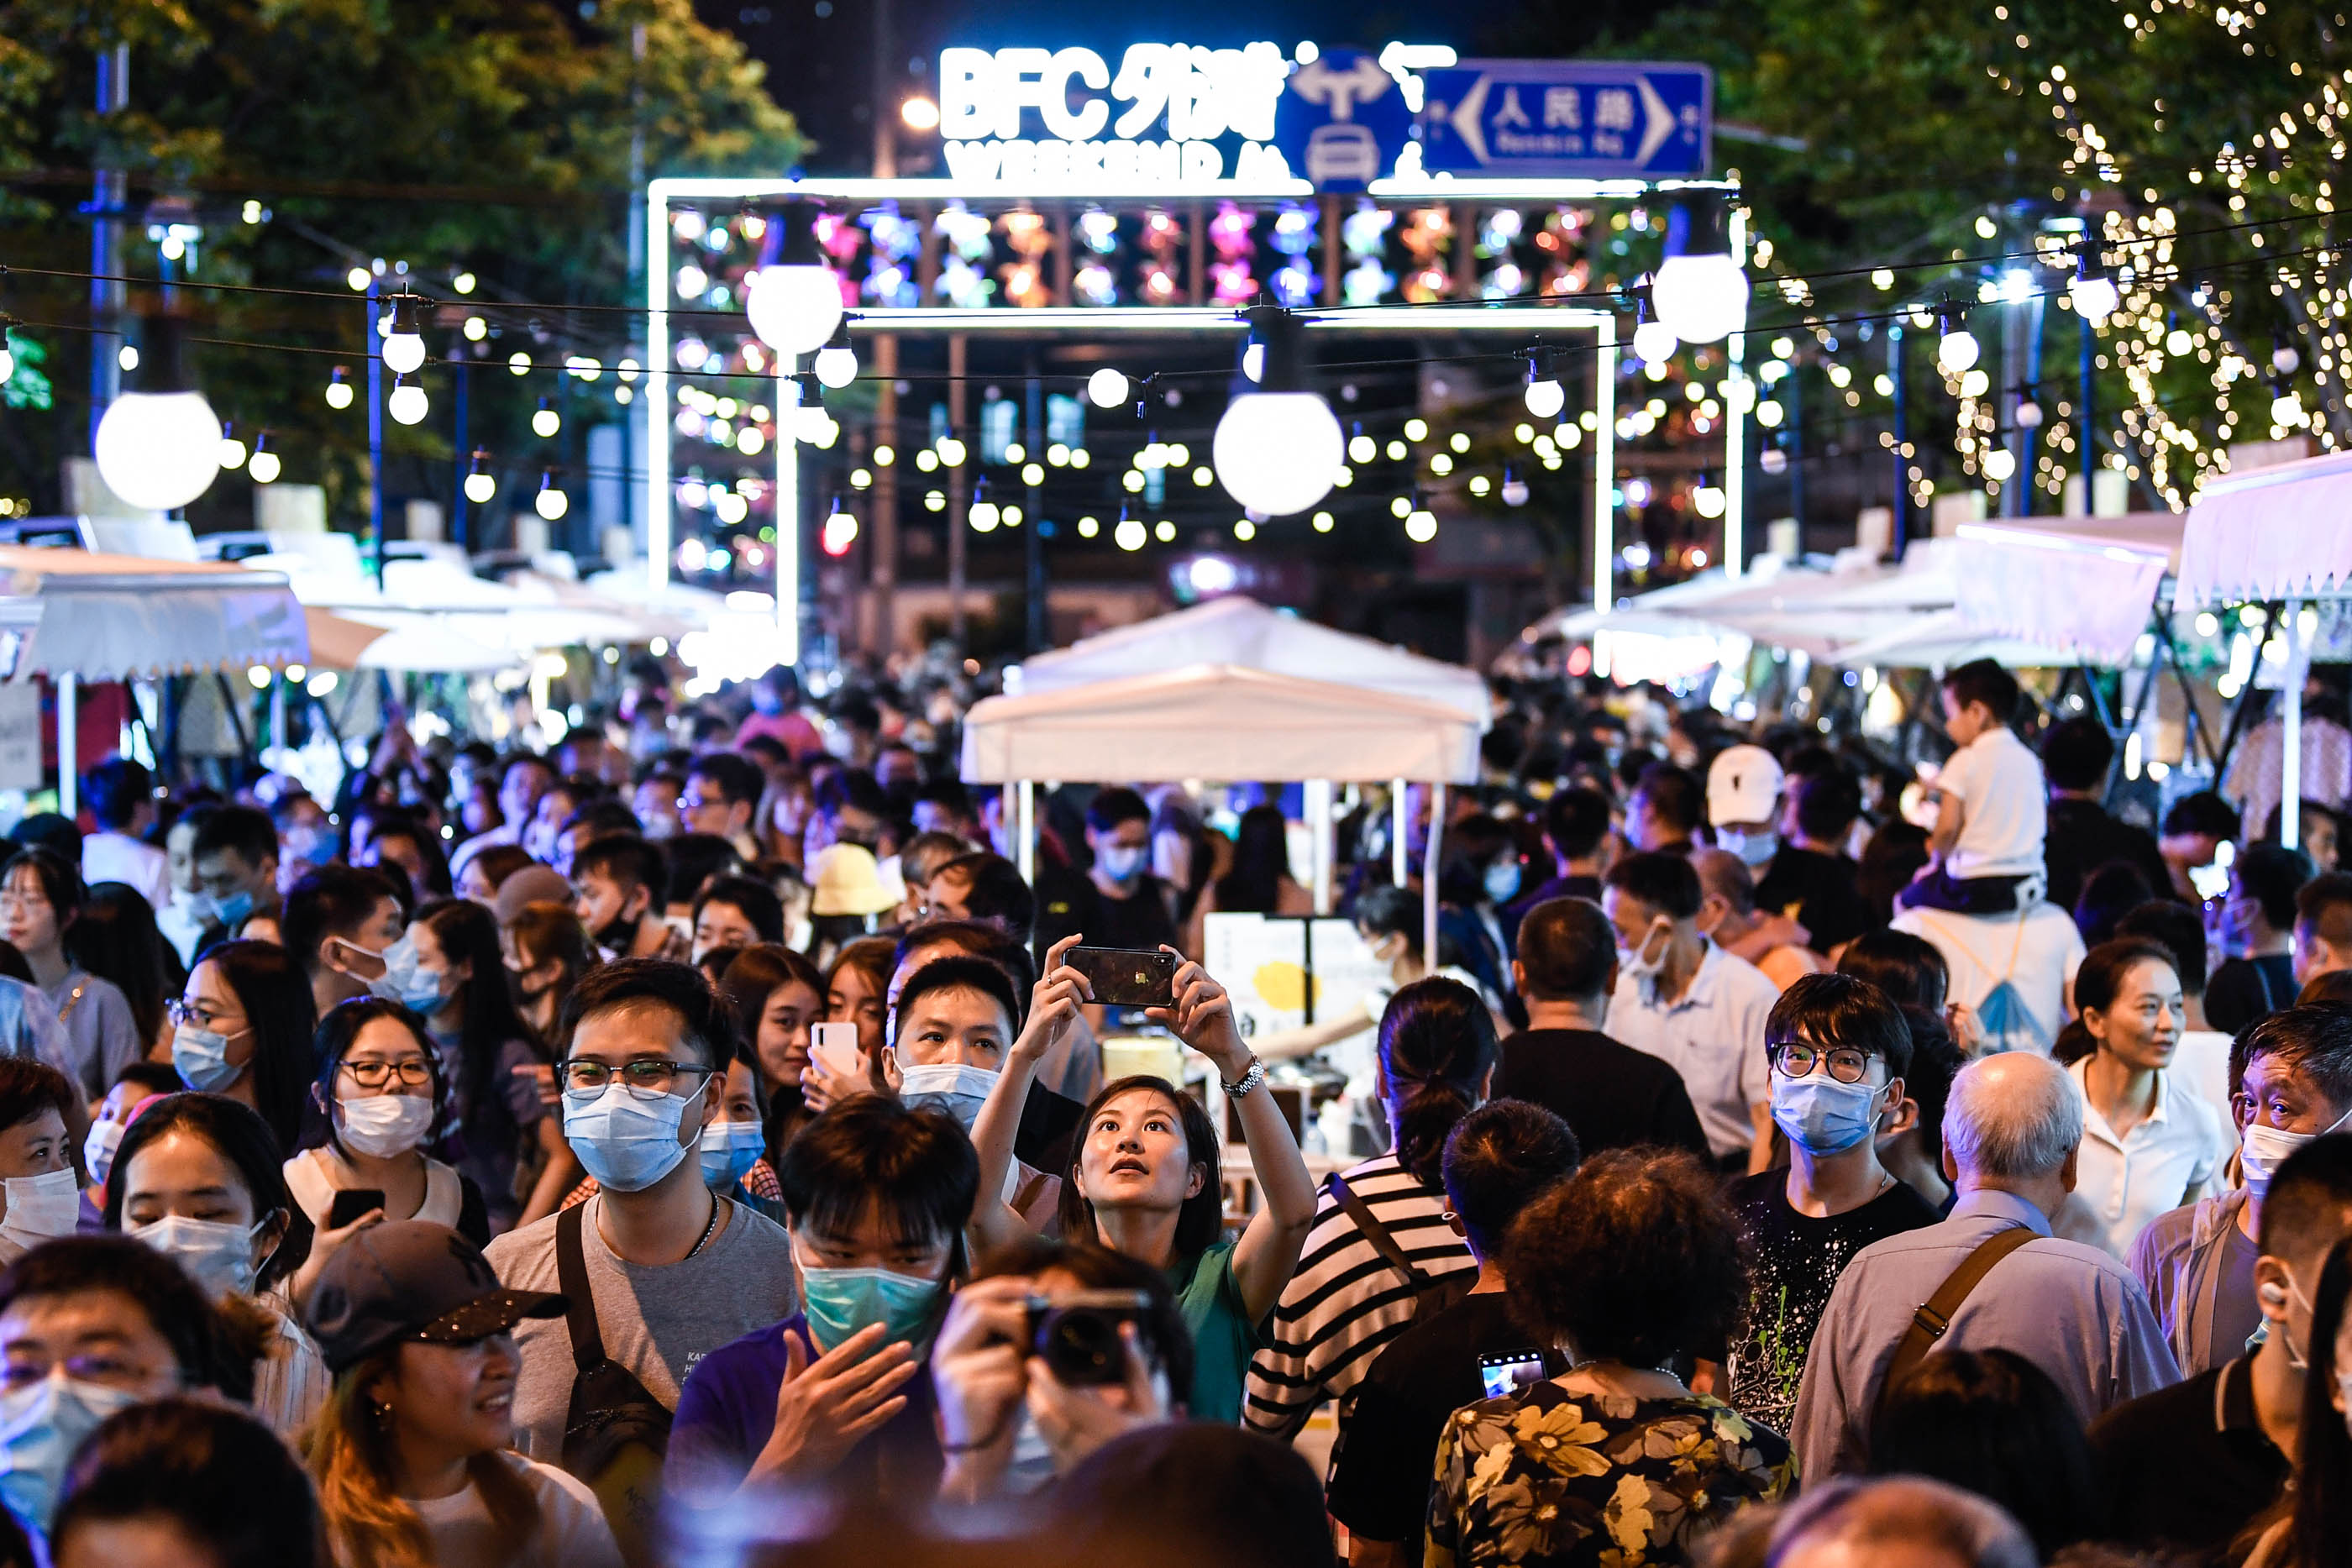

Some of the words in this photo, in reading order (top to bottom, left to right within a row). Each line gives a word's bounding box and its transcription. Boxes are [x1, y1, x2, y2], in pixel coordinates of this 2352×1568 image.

[1492, 86, 1635, 131] 人民路
[943, 139, 1224, 181] WEEKEND
